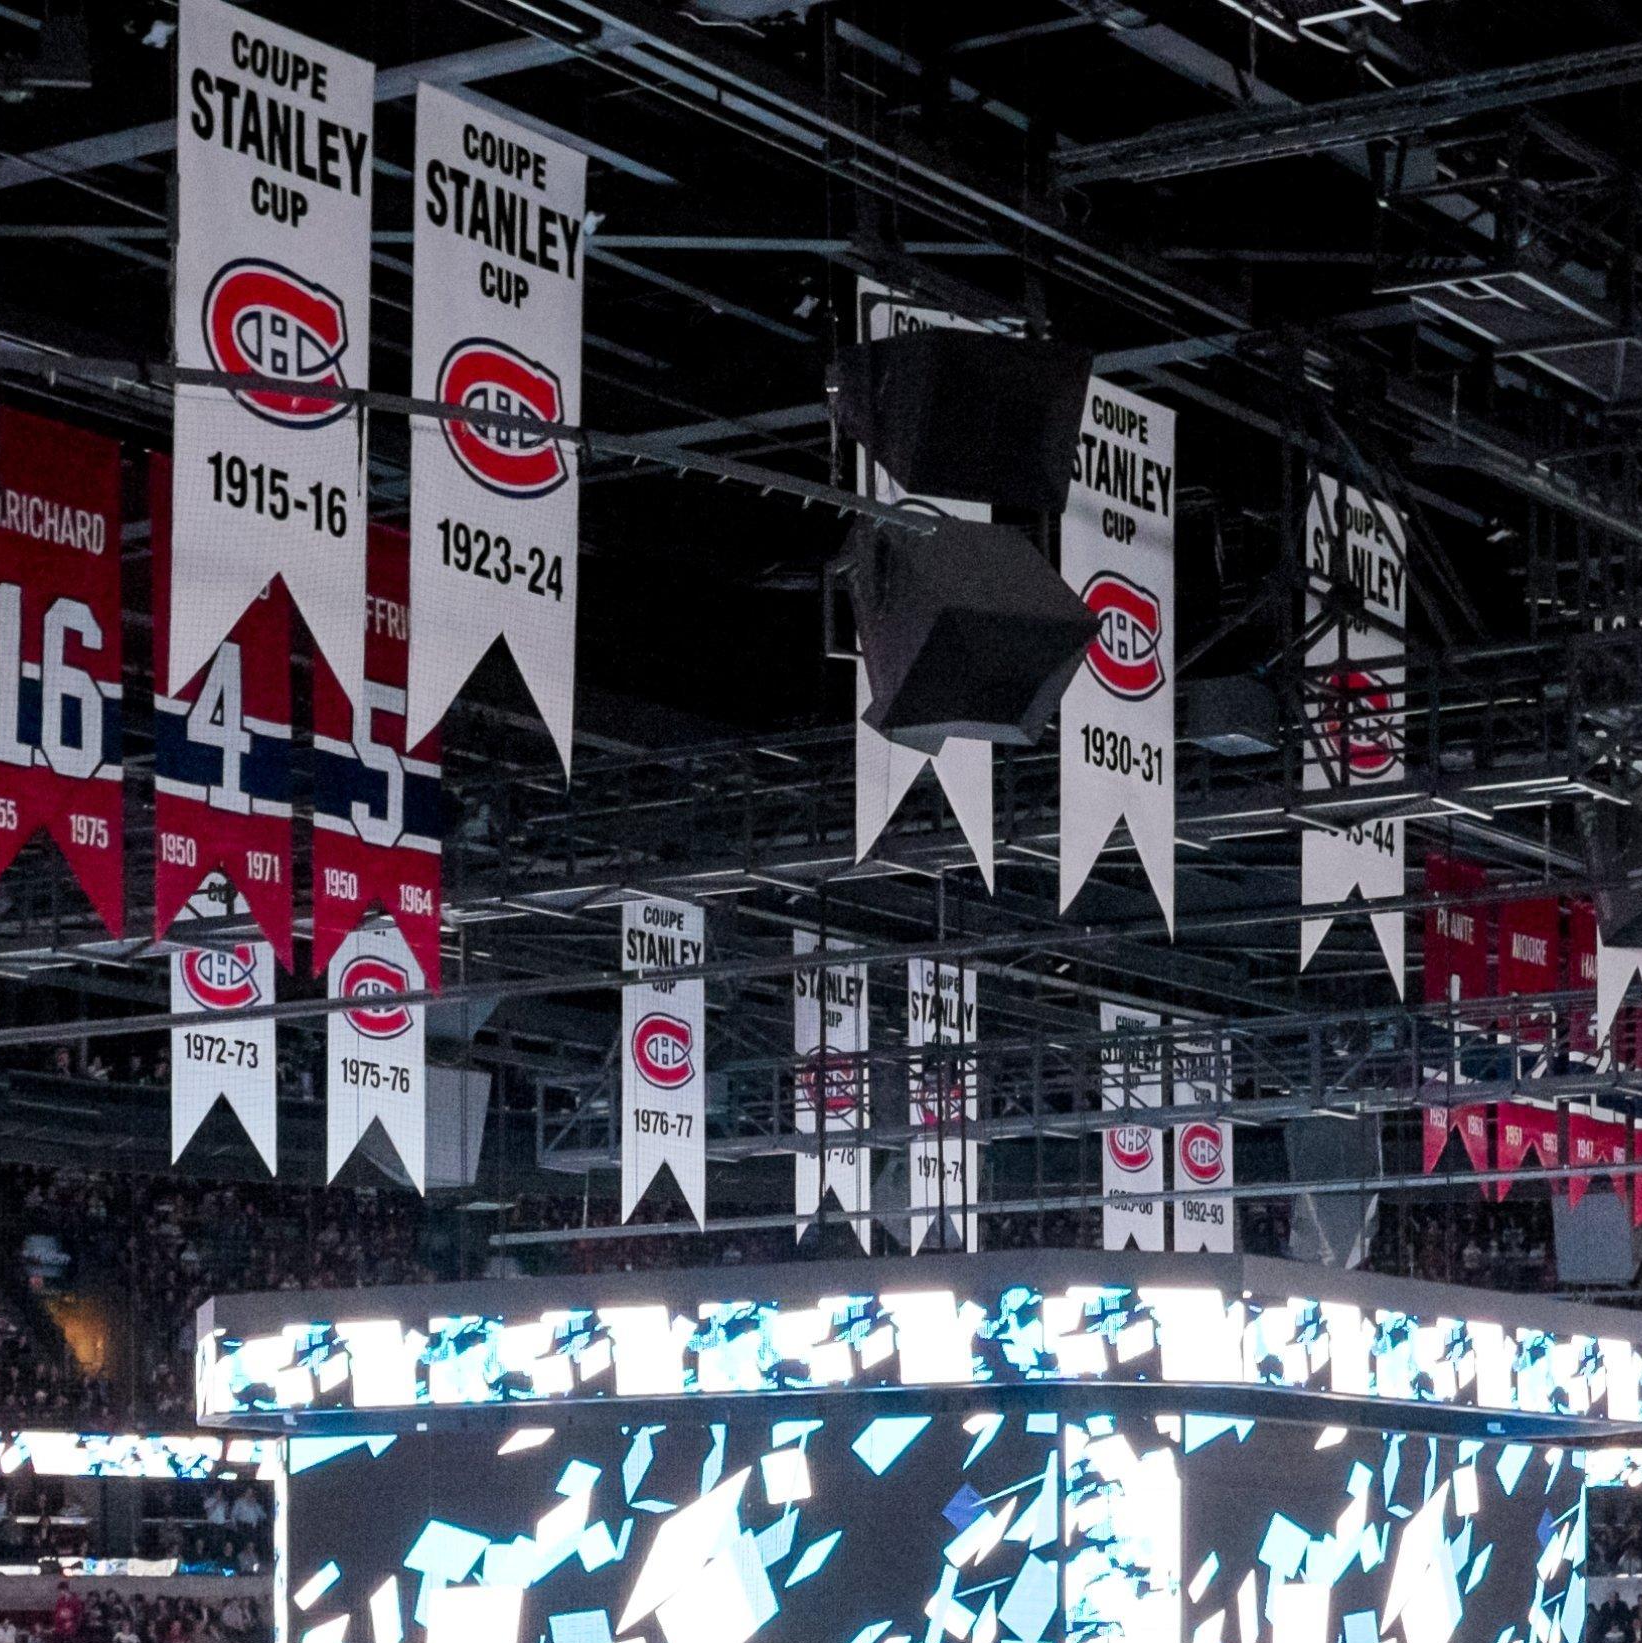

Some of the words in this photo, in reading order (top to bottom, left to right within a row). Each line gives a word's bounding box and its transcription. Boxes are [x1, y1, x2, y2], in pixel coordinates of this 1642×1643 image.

[232, 30, 328, 102] COUPE
[190, 68, 368, 198] STANLEY
[462, 123, 547, 191] COUPE
[250, 176, 308, 229] CUP
[425, 158, 581, 280] STANLEY
[479, 261, 530, 309] CUP
[1092, 395, 1148, 444] COUPE
[207, 451, 347, 538] 1915-16
[1103, 508, 1136, 545] CUP
[436, 518, 564, 602] 1923-24
[186, 643, 250, 813] 4
[1080, 724, 1163, 786] 1930-31
[69, 813, 109, 848] 1975
[160, 831, 197, 868] 1950
[246, 850, 281, 884] 1971
[323, 867, 358, 901] 1950
[398, 883, 434, 917] 1964
[642, 905, 685, 932] COUPE
[626, 929, 701, 967] STANLEY
[1512, 932, 1548, 966] MOORE
[184, 1033, 259, 1069] 1972-73
[340, 1057, 411, 1093] 1975-76
[633, 1110, 694, 1138] 1976-77
[1181, 1200, 1225, 1225] 1992-93
